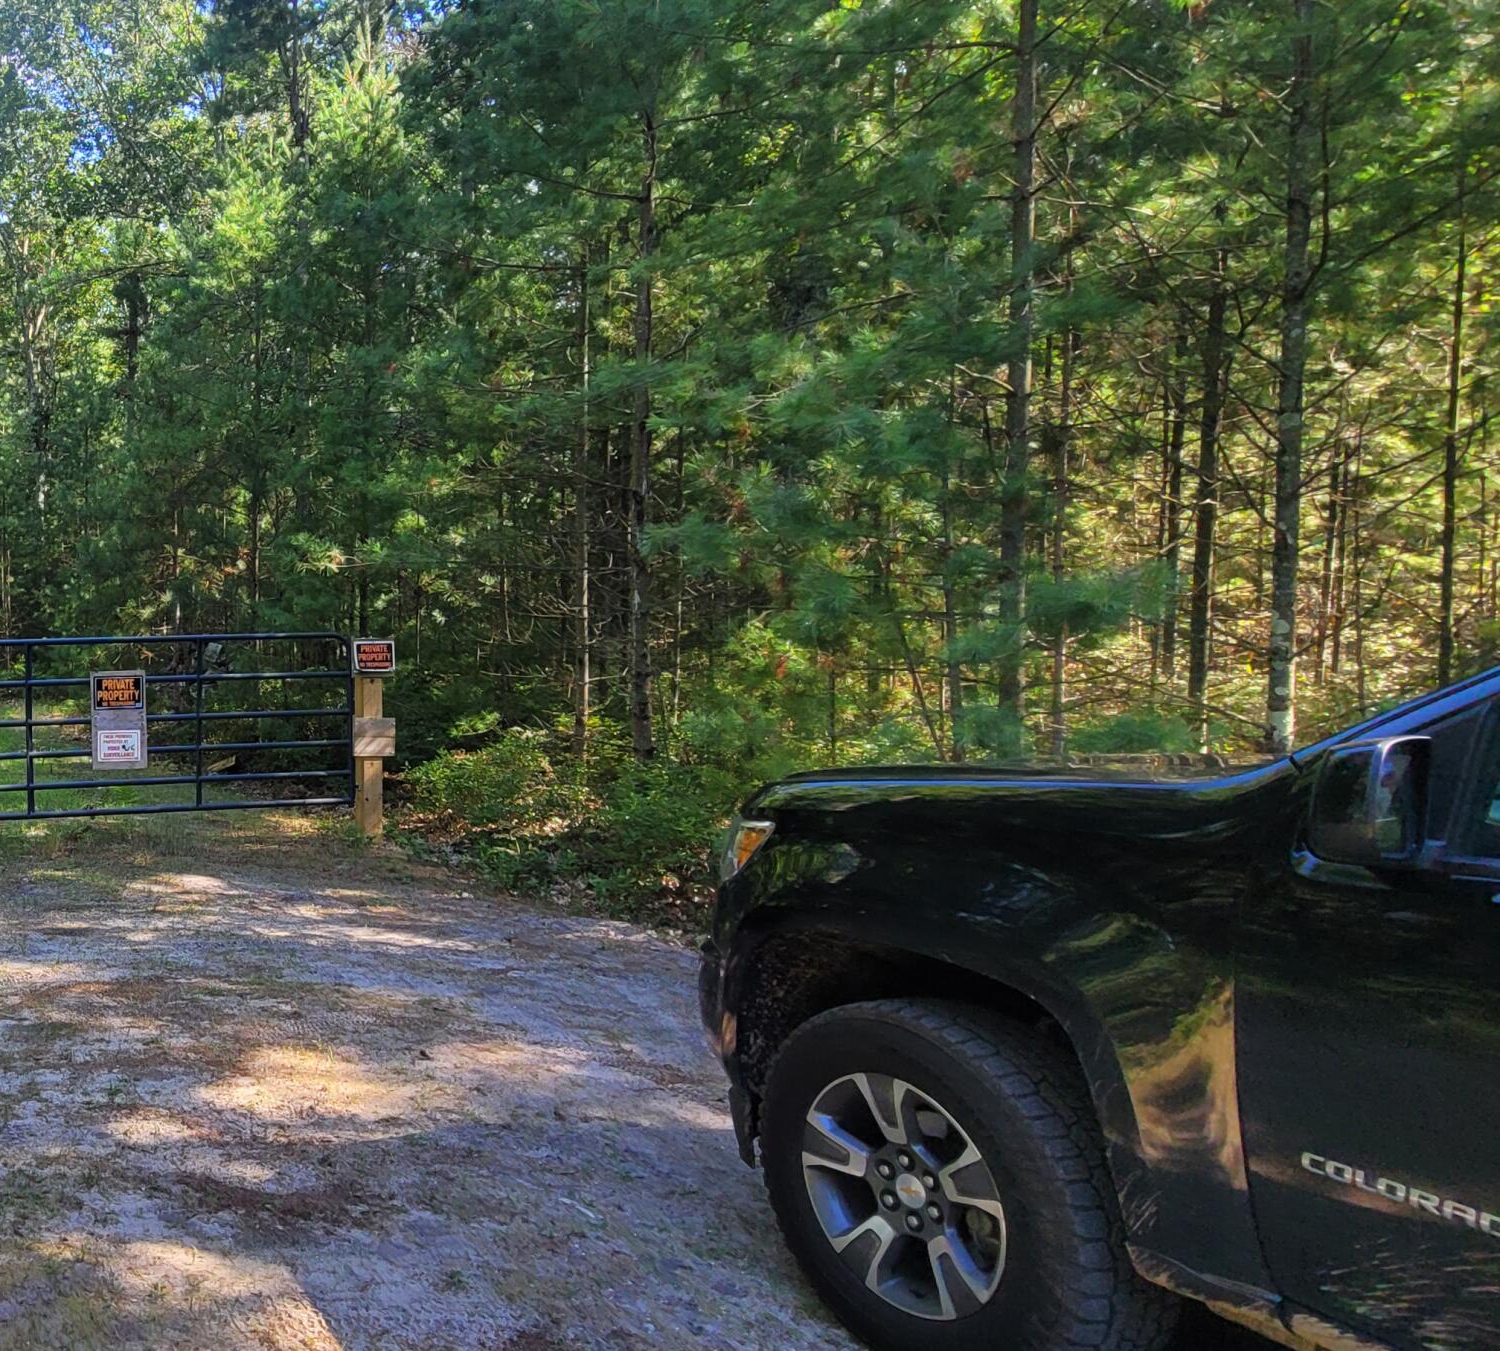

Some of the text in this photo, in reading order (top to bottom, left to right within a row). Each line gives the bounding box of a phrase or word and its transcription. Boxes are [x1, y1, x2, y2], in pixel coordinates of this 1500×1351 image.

[360, 644, 388, 653] PRIVATE
[358, 653, 391, 661] PROPERTY
[102, 679, 135, 690] PRIVATE
[97, 689, 140, 702] PROPERTY
